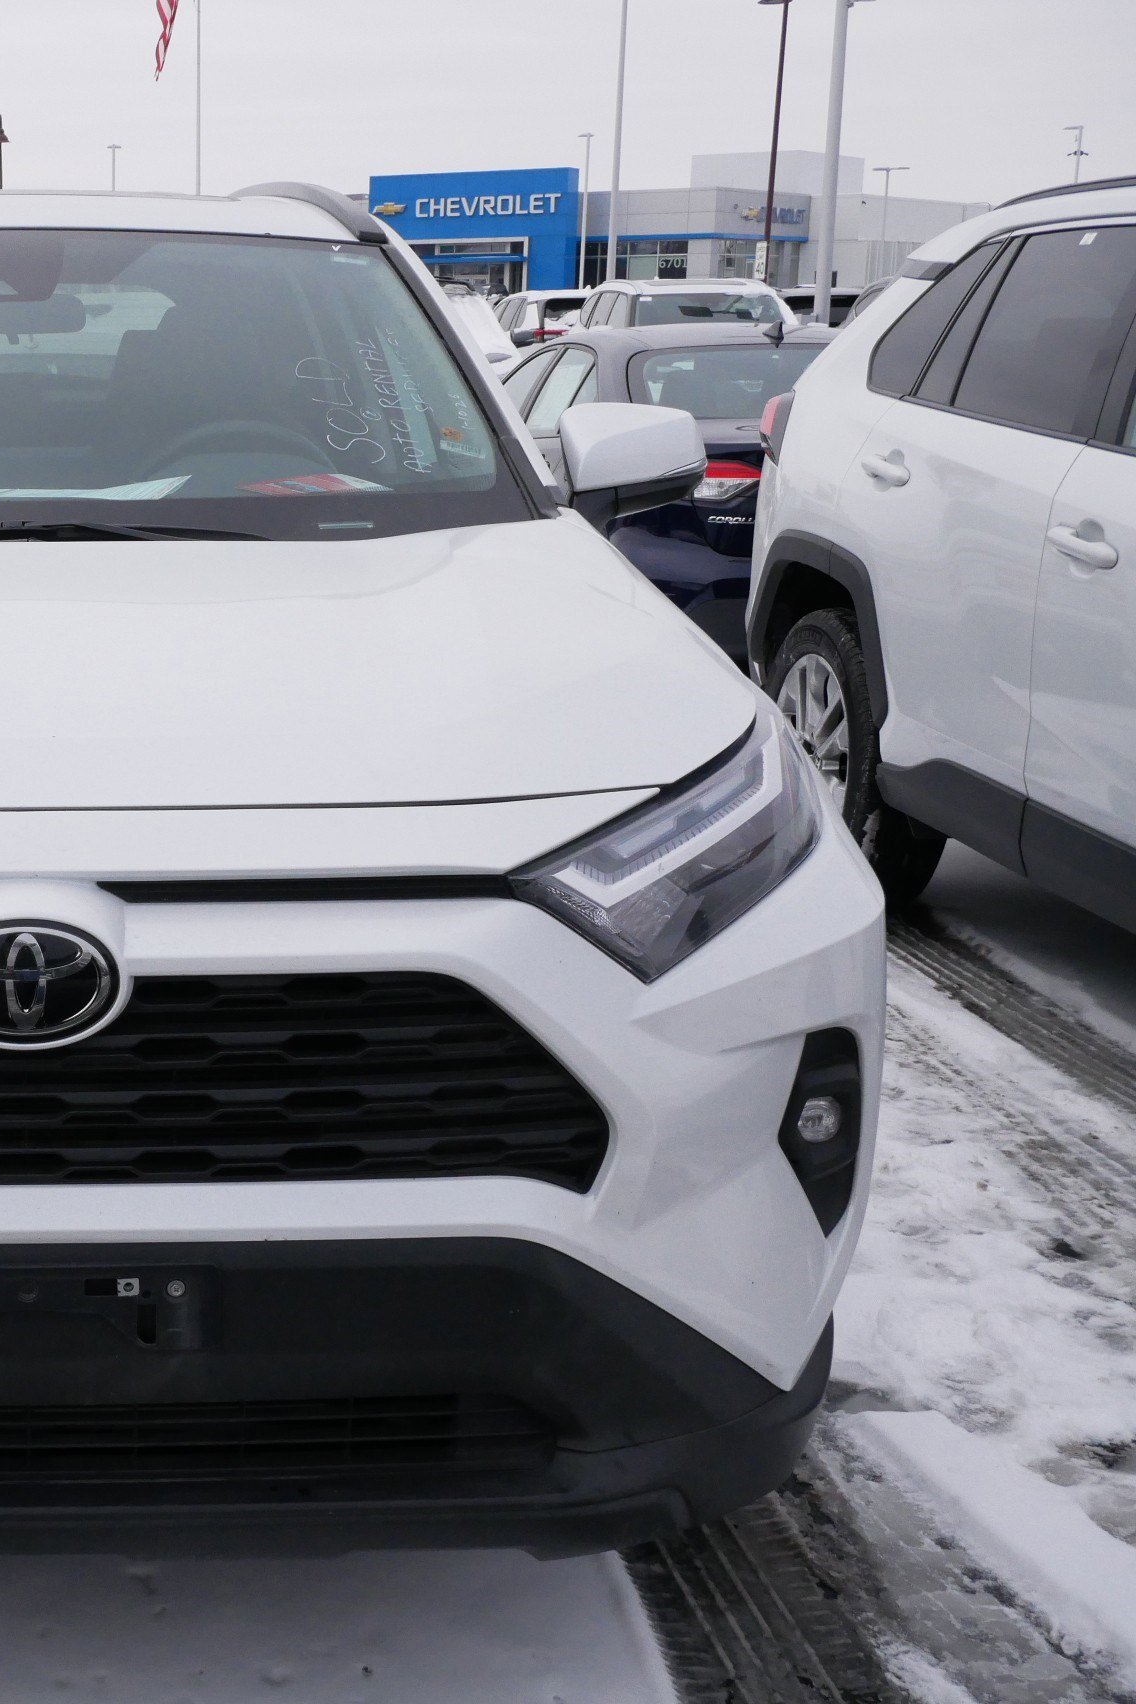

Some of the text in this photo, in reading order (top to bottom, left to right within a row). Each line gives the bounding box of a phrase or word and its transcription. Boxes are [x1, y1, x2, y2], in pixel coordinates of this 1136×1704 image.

[416, 193, 561, 218] CHEVROLET
[659, 257, 687, 269] 6701
[755, 262, 764, 275] 40
[295, 356, 386, 464] SOLD
[707, 515, 755, 524] COROLL
